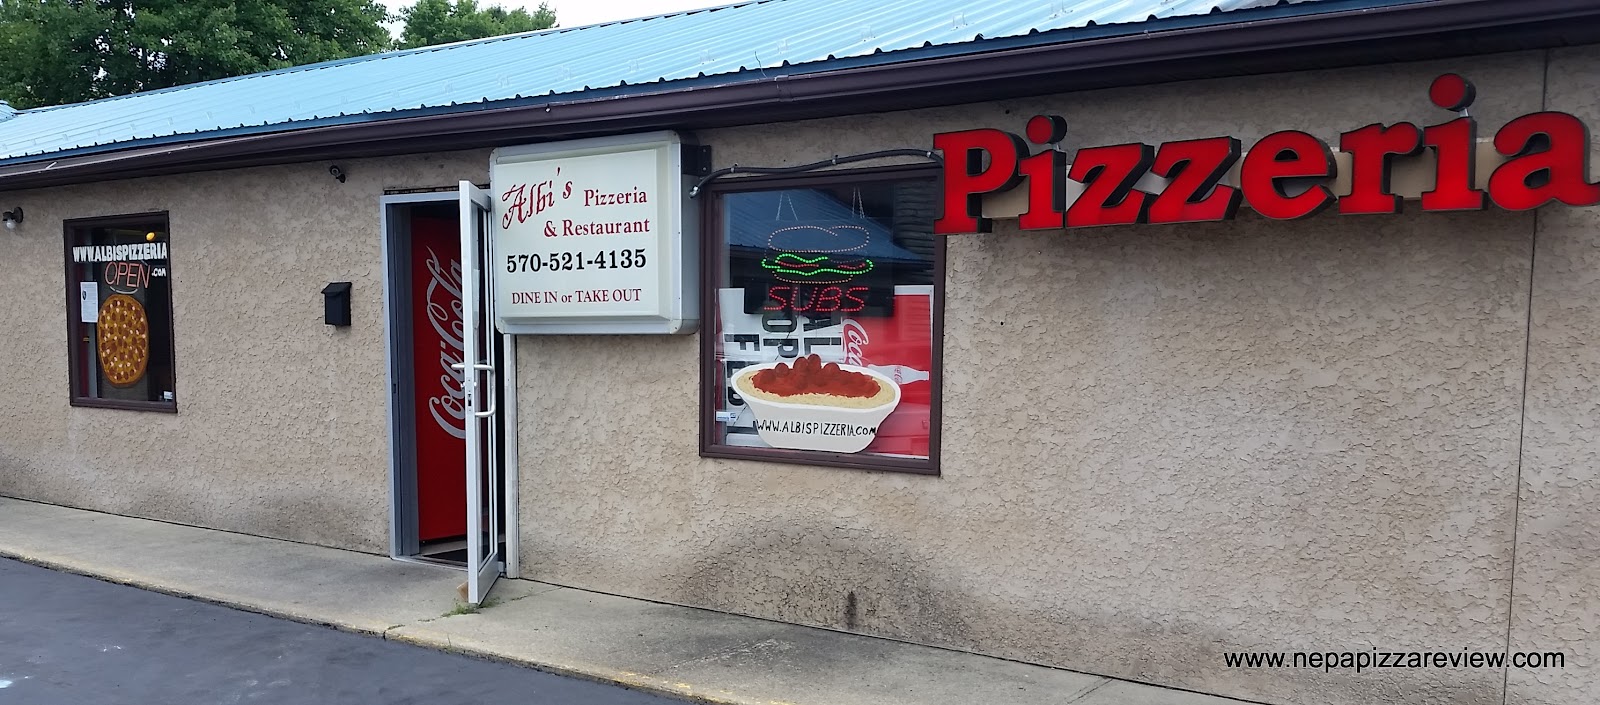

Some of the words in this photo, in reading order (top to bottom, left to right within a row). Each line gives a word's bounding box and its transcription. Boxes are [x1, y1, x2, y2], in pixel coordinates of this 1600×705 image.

[933, 73, 1600, 234] Pizzeria
[501, 167, 573, 229] Albi's
[583, 186, 648, 207] Pizzeria
[543, 220, 558, 238] &
[562, 218, 650, 236] Restaurant
[506, 248, 647, 273] 570-521-4135
[105, 262, 150, 288] OPEN
[512, 292, 541, 304] DINE
[544, 291, 558, 303] IN
[561, 294, 573, 304] or
[575, 290, 609, 303] TAKE
[612, 289, 642, 302] OUT
[763, 286, 870, 312] SUBS
